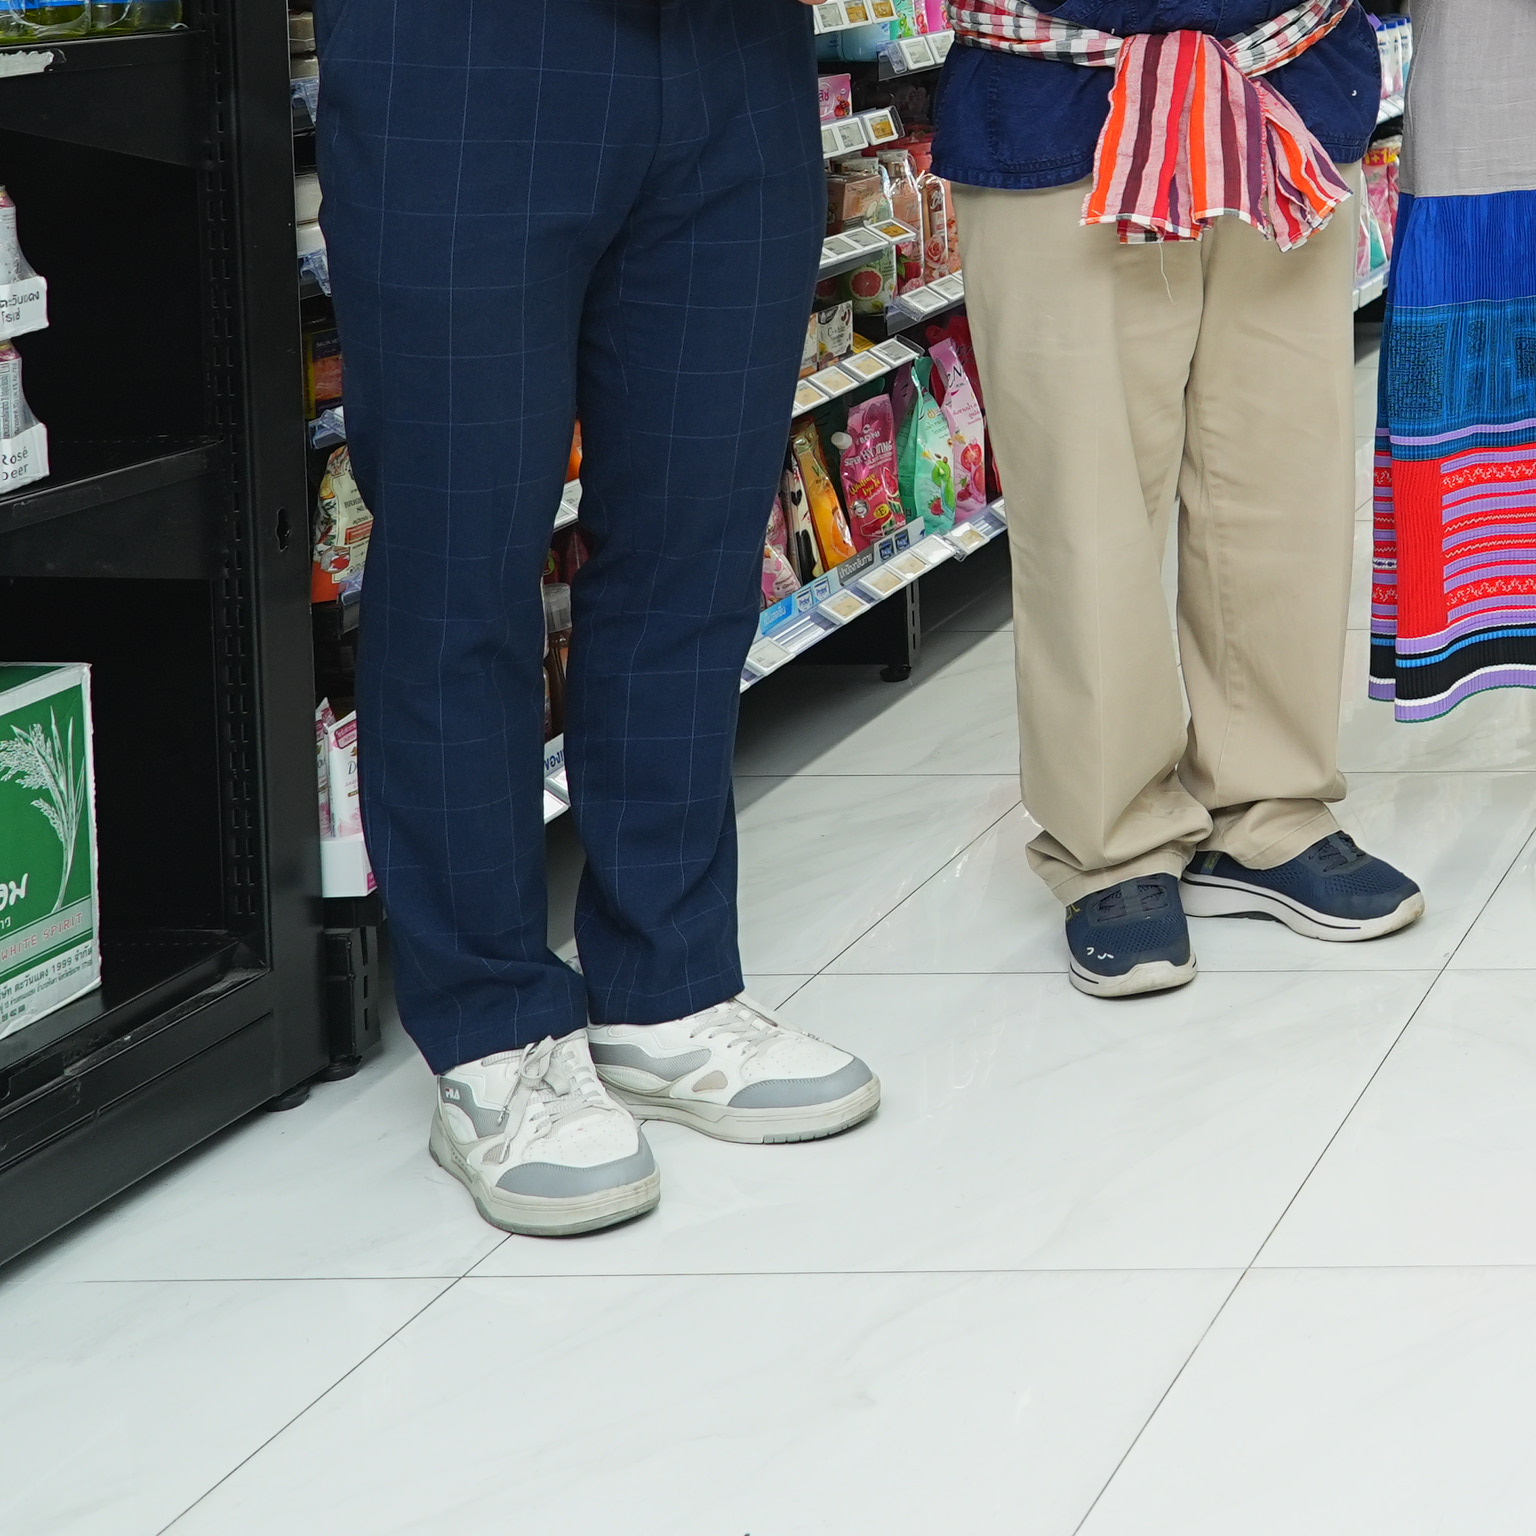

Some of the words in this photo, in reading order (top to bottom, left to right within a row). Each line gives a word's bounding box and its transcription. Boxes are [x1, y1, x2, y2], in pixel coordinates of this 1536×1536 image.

[1, 934, 39, 961] WHITE
[43, 912, 84, 941] SPIRIT
[51, 956, 73, 977] 1999
